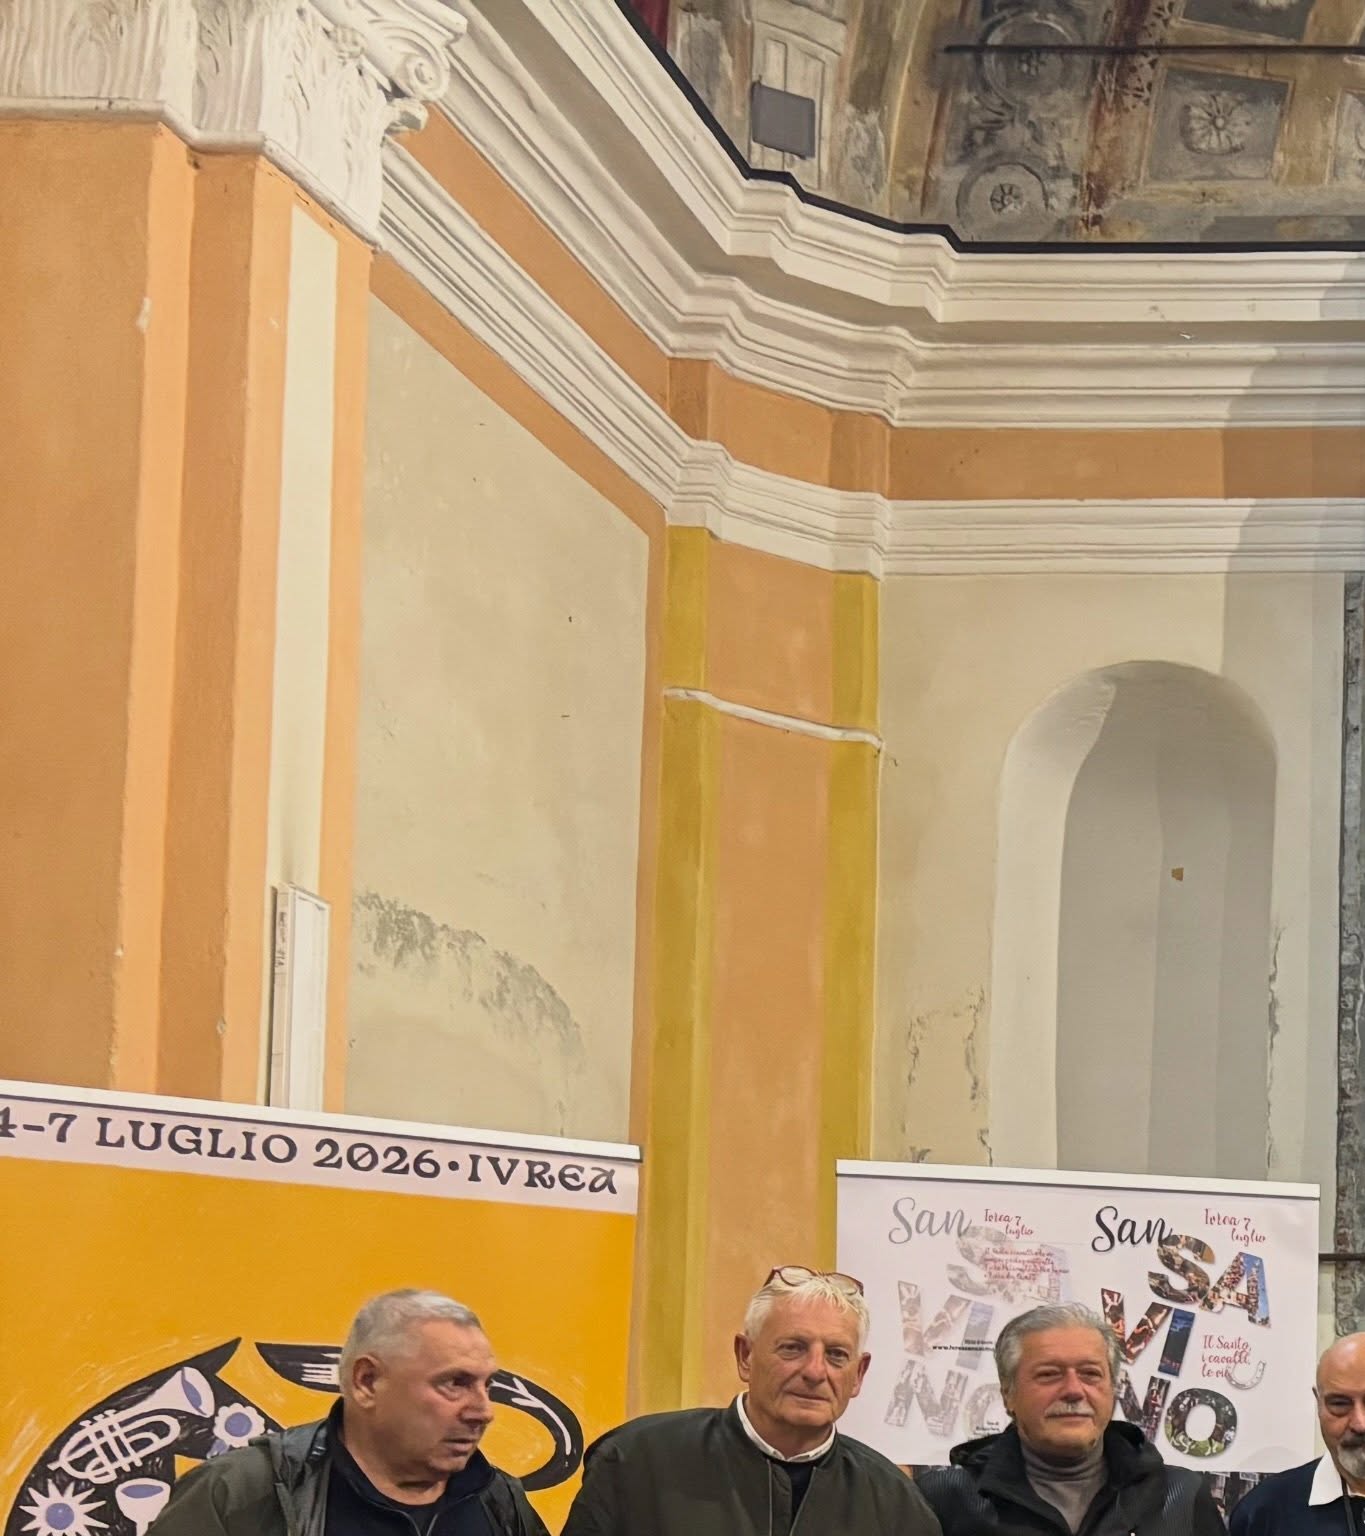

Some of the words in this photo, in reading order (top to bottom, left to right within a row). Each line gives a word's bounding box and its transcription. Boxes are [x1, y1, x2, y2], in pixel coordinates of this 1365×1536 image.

[96, 1116, 298, 1164] LUGLIO
[888, 1197, 972, 1244] San
[1091, 1206, 1174, 1252] San
